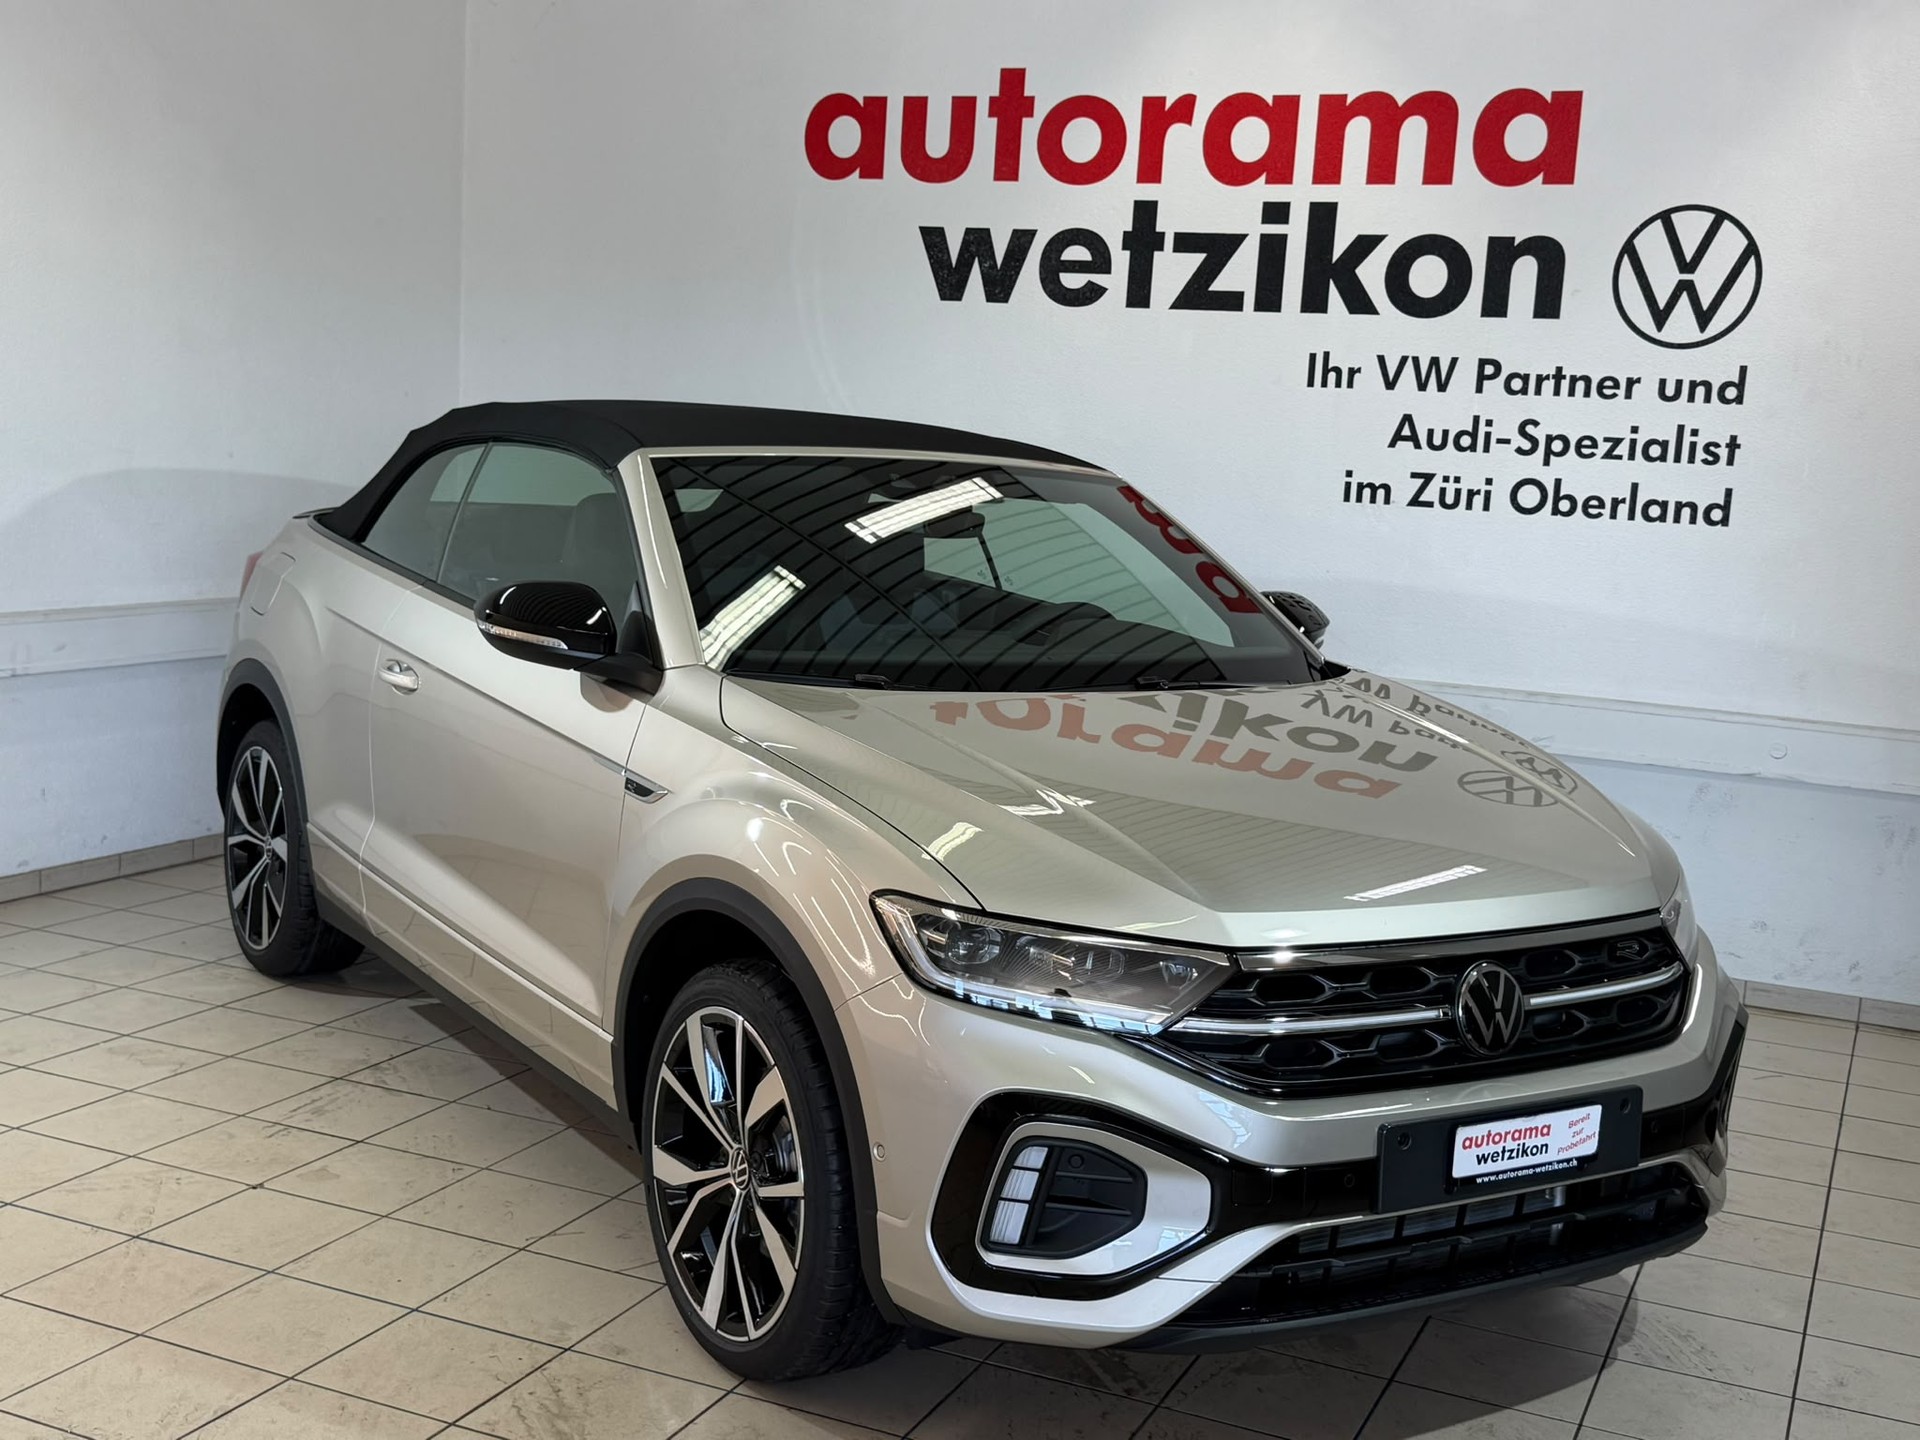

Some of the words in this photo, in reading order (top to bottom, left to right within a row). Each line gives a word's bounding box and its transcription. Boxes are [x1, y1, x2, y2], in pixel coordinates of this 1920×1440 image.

[805, 67, 1582, 187] autorama
[919, 200, 1565, 319] wetzikon
[1306, 352, 1362, 389] Ihr
[1377, 355, 1460, 393] VW
[1474, 358, 1642, 400] Partner
[1657, 365, 1748, 406] und
[1387, 414, 1742, 467] Audi-Spezialist
[1343, 469, 1392, 506] im
[1406, 472, 1494, 512] Züri
[1509, 478, 1734, 528] Oberland
[1568, 1112, 1591, 1129] Bereit
[1571, 1126, 1585, 1139] zur
[1461, 1123, 1552, 1151] autorama
[1557, 1131, 1597, 1156] Probefahrt
[1475, 1142, 1549, 1166] wetzikon
[1475, 1158, 1578, 1184] www.autorama-wetzikon.ch
